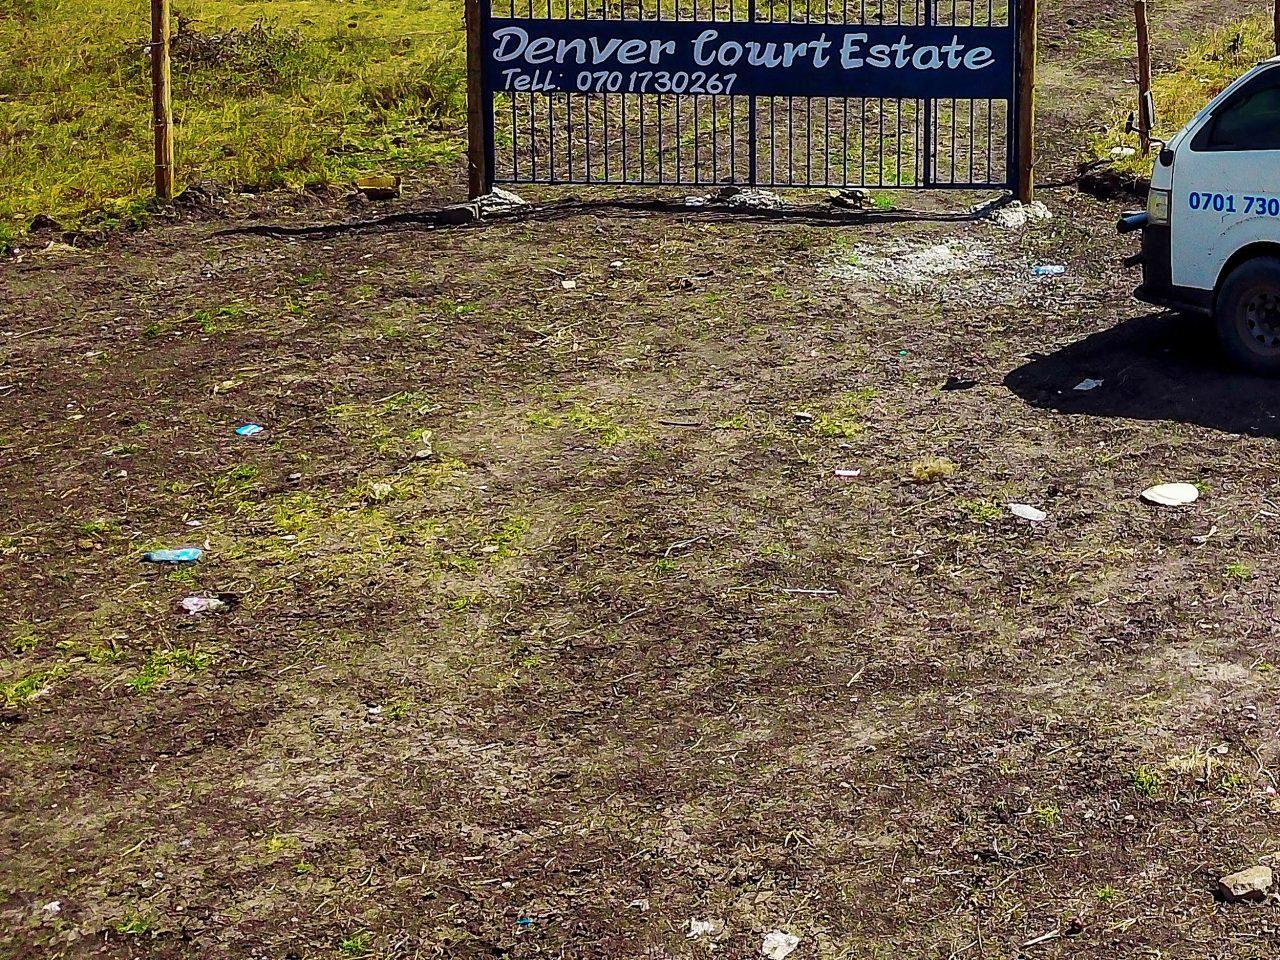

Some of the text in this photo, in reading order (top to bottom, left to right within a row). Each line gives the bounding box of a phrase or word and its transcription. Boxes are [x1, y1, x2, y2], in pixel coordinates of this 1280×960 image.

[493, 26, 995, 71] Denver Court Estate
[1188, 191, 1237, 214] 0701
[1243, 196, 1280, 217] 730
